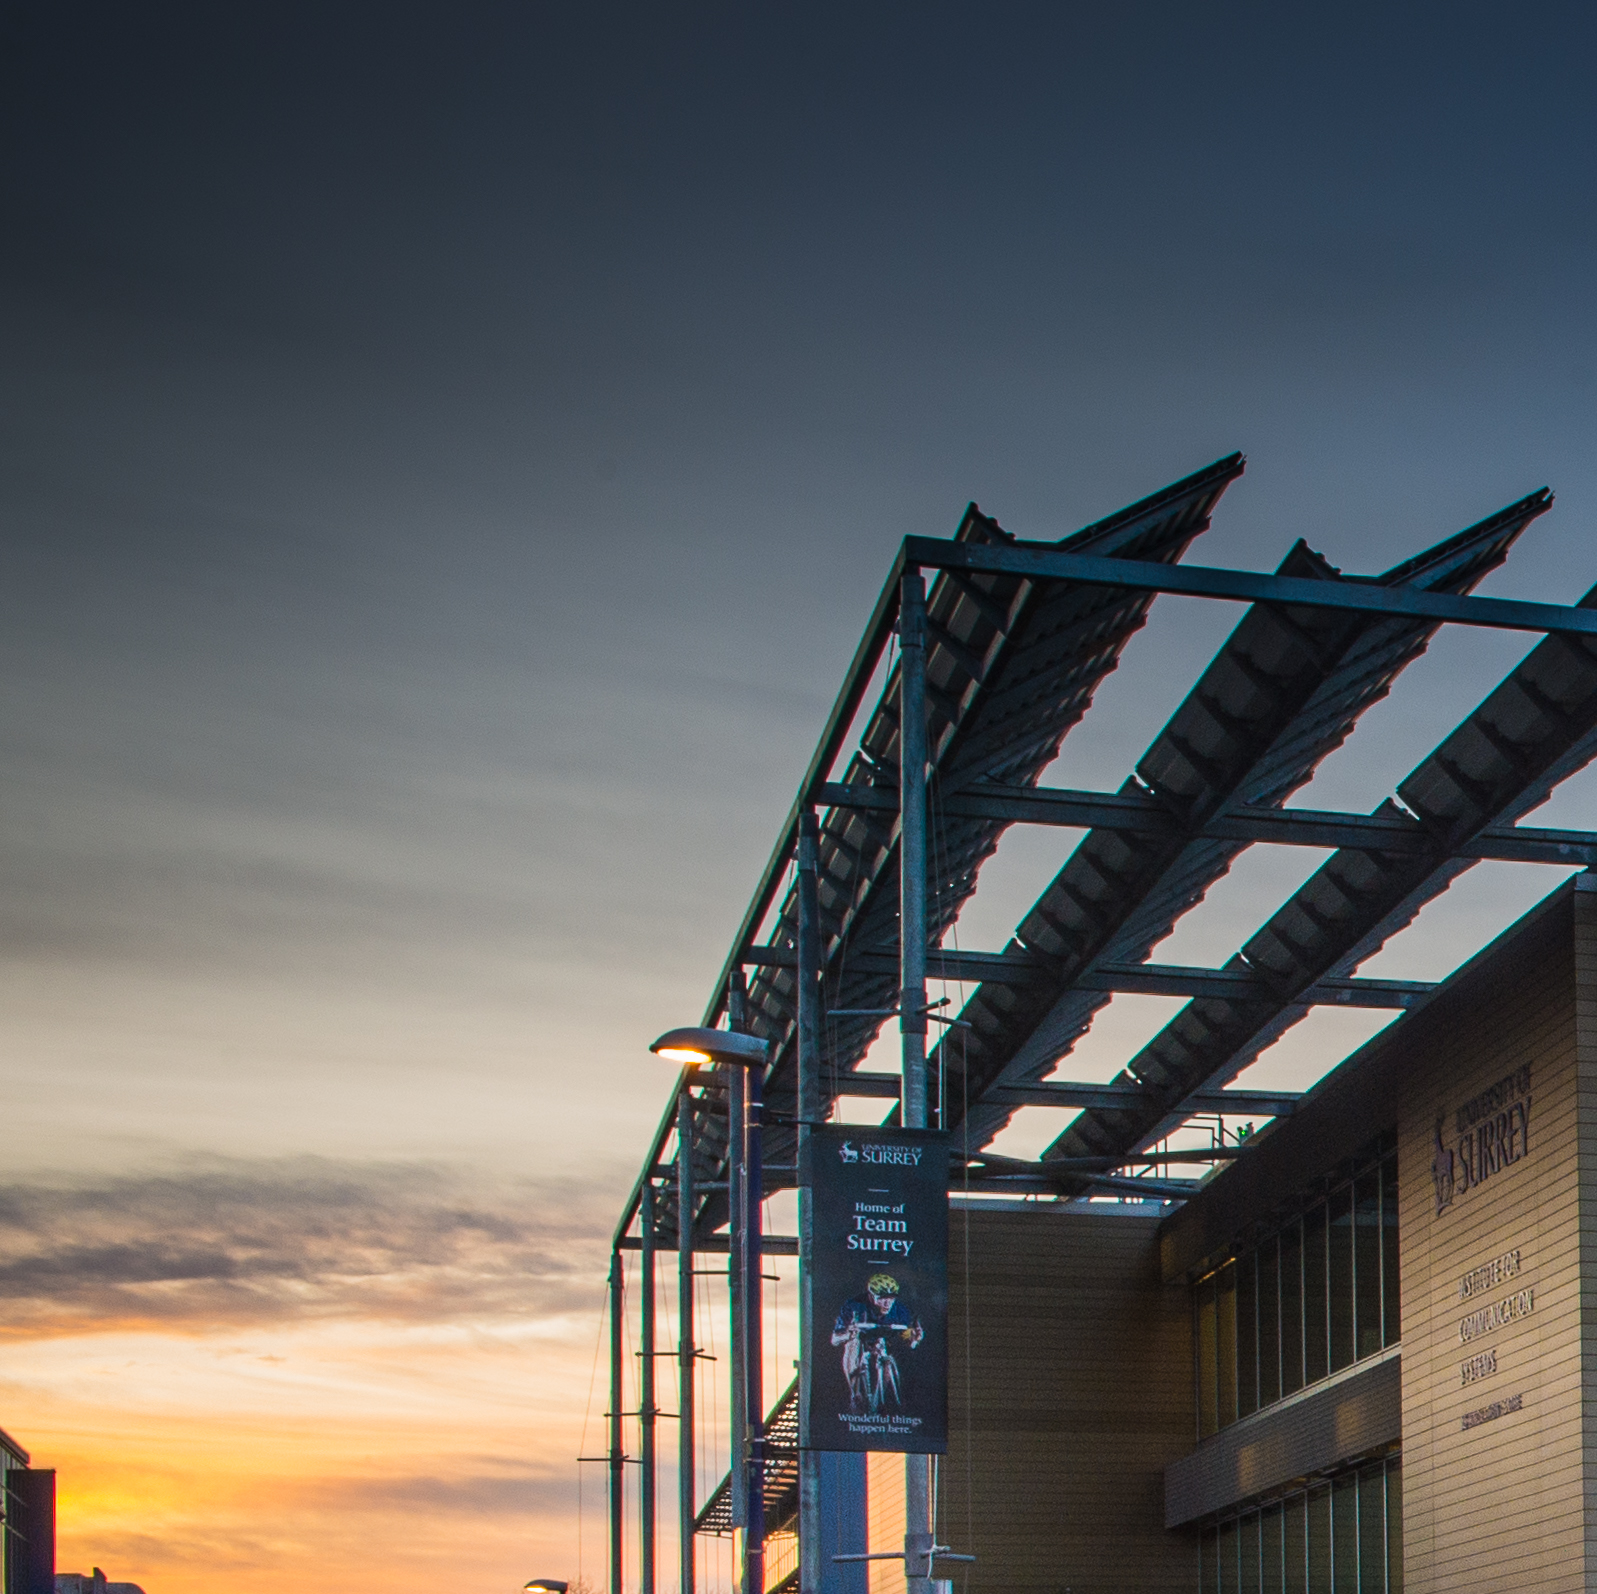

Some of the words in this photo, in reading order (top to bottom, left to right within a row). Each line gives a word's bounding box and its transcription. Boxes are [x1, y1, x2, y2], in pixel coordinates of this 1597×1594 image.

[861, 1144, 910, 1153] UNIVERSITY
[1457, 1095, 1532, 1194] SURREY
[861, 1151, 922, 1166] SURREY
[855, 1202, 890, 1213] Home
[892, 1203, 906, 1214] of
[852, 1215, 908, 1233] Team
[847, 1234, 914, 1257] Surrey
[1459, 1259, 1501, 1300] INSTITUTE
[1502, 1250, 1521, 1277] FOR
[1459, 1289, 1534, 1342] COMMUNICATION
[1460, 1350, 1497, 1385] SYSTEMS
[838, 1413, 890, 1423] Wonderful
[892, 1414, 922, 1427] things
[848, 1422, 886, 1434] happen
[888, 1424, 912, 1434] here.
